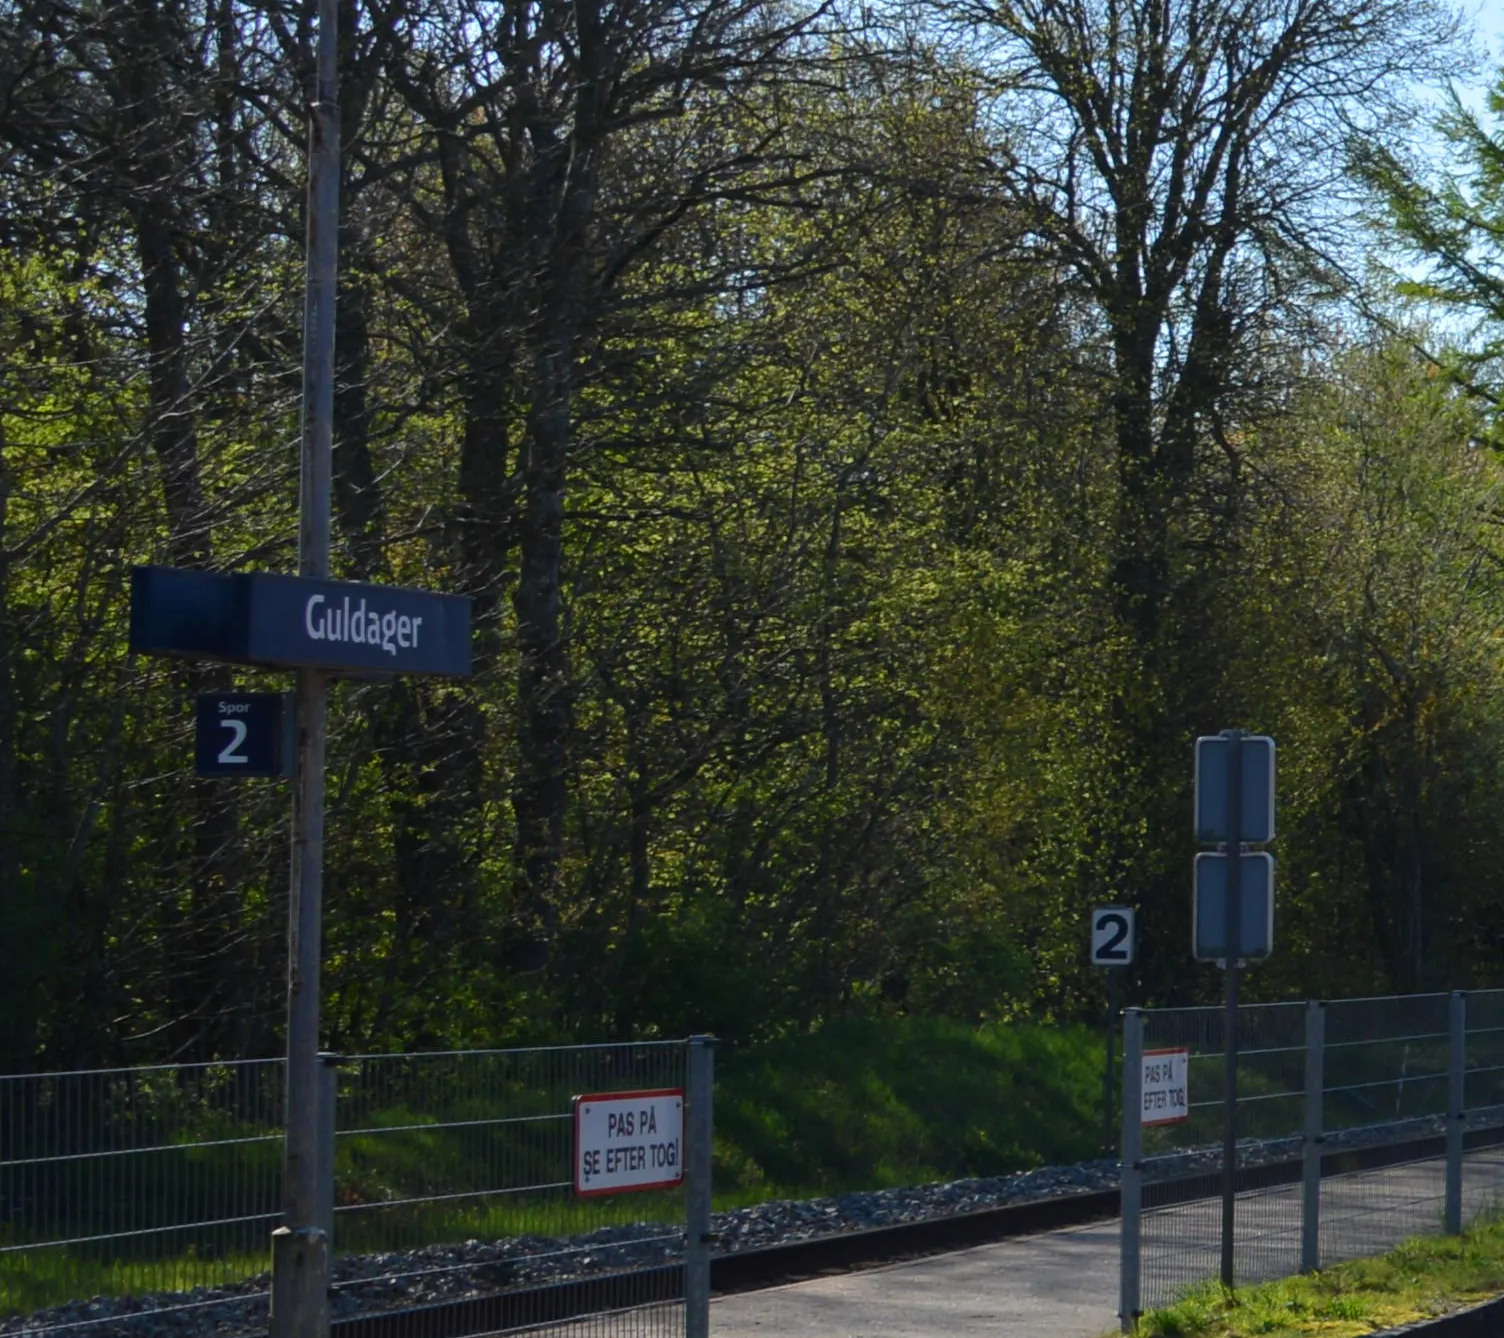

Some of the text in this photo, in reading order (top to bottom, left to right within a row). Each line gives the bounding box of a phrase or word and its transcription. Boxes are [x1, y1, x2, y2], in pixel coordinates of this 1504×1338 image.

[305, 593, 423, 656] Guldager
[218, 701, 251, 716] Spor
[218, 719, 248, 764] 2
[1095, 913, 1129, 960] 2
[1145, 1064, 1161, 1083] PAS
[608, 1105, 657, 1138] PAS PÅ
[583, 1138, 679, 1175] SE EFTER TOG!
